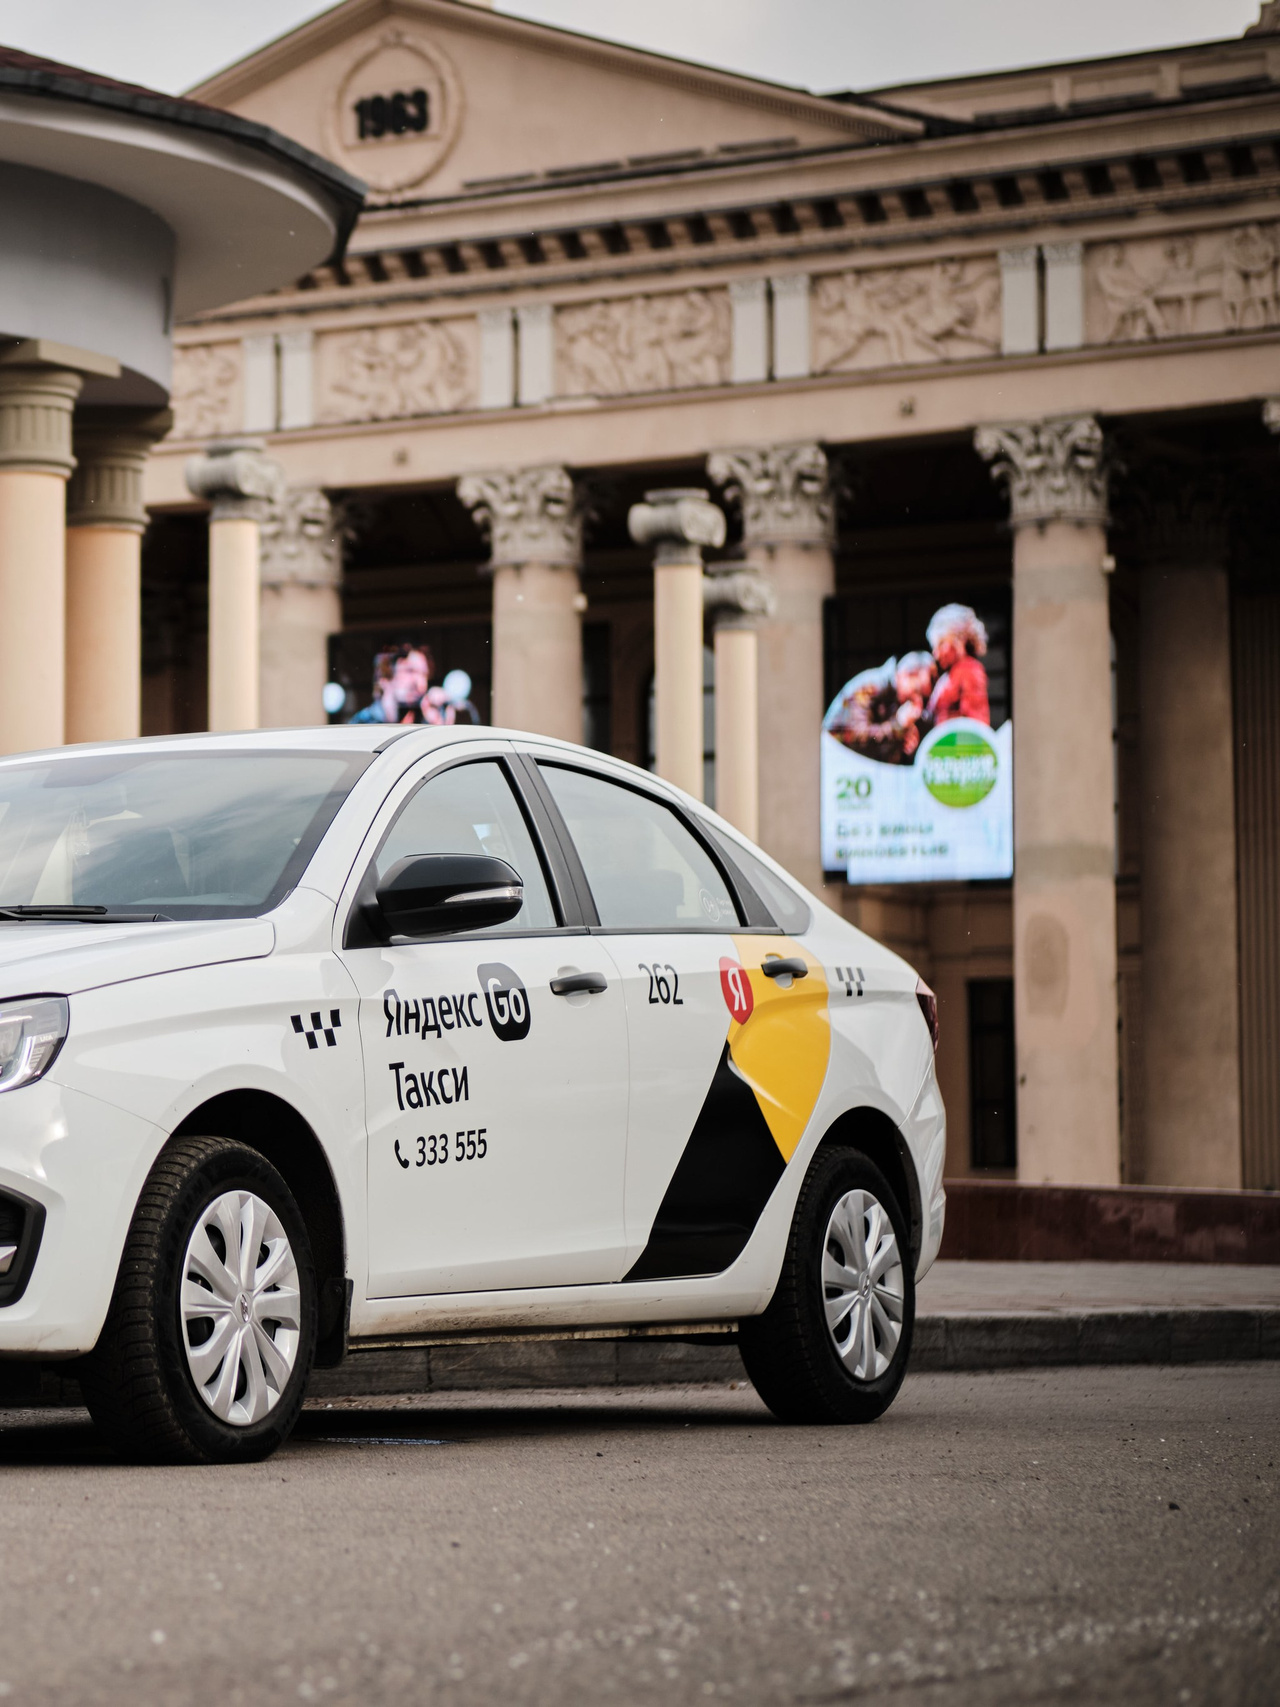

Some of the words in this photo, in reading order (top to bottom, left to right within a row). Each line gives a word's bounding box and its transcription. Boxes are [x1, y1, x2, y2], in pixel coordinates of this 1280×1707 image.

[835, 775, 872, 800] 20
[638, 963, 683, 1005] 262
[727, 967, 747, 1011] Я
[383, 988, 483, 1040] Яндекс
[487, 977, 526, 1025] Go
[388, 1062, 470, 1111] Такси
[415, 1133, 449, 1167] 333
[455, 1128, 488, 1161] 555
